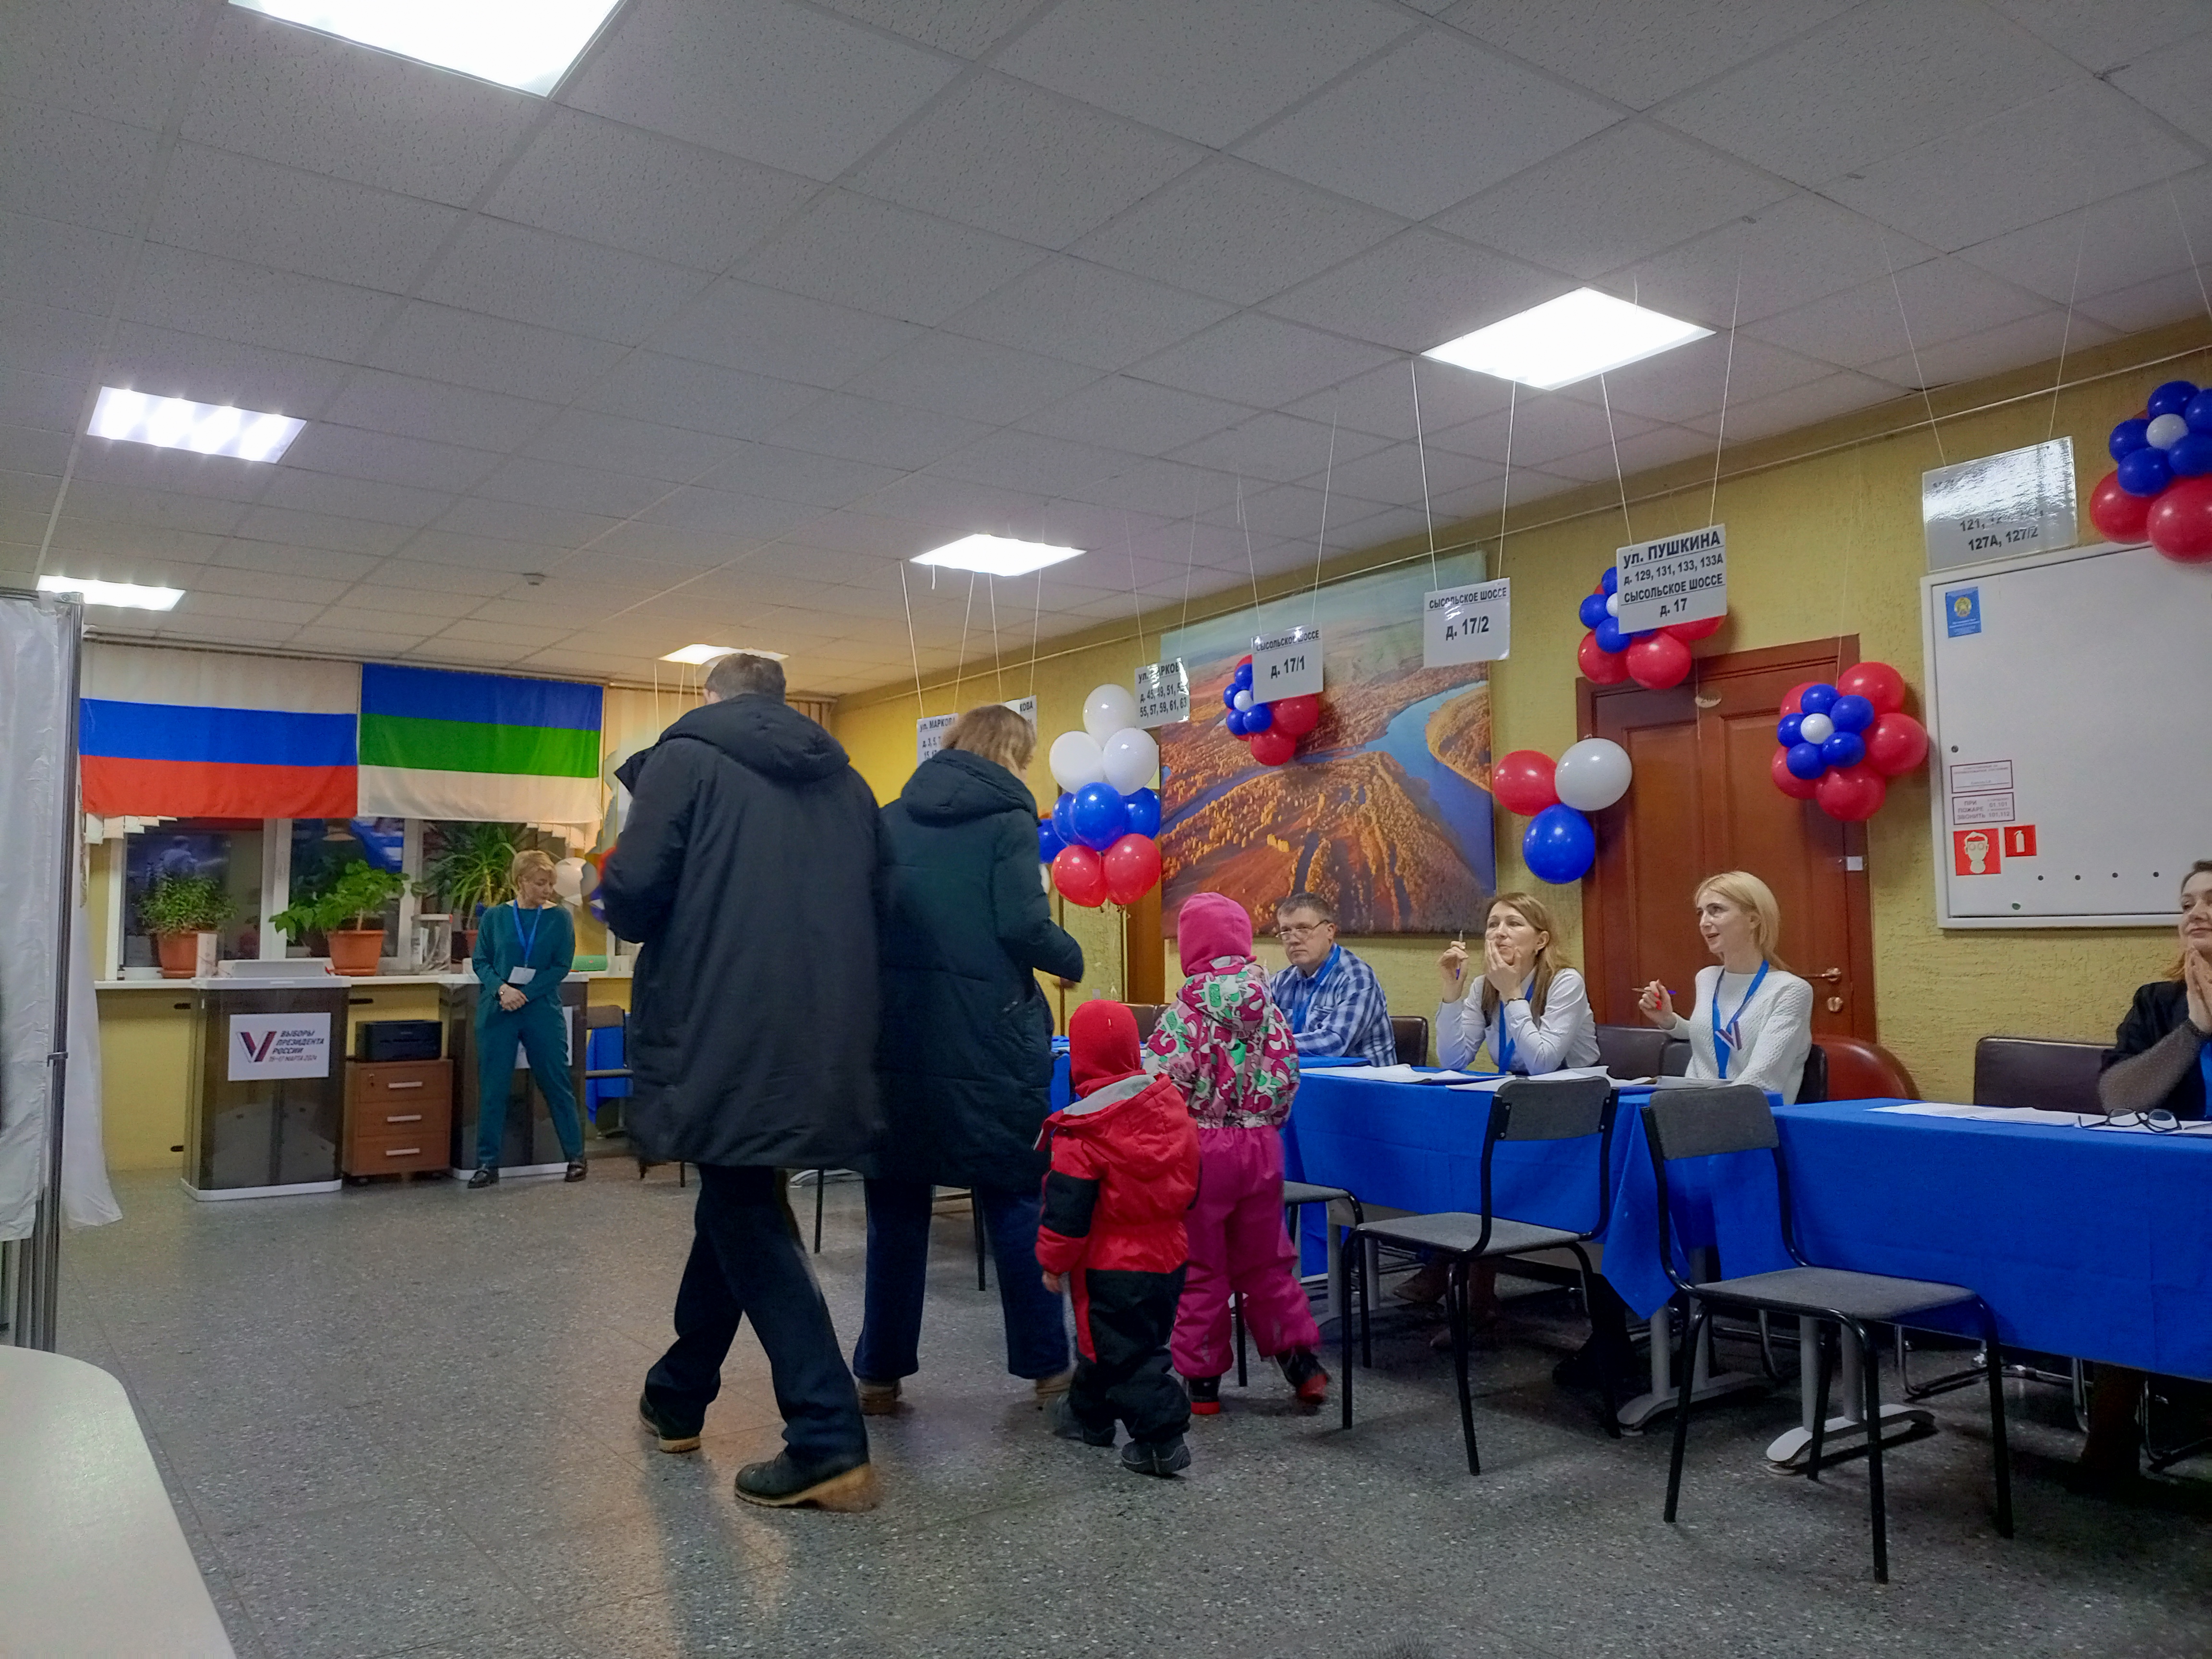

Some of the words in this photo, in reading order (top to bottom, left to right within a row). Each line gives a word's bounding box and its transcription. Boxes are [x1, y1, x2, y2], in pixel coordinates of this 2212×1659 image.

[1960, 518, 1985, 531] 121,
[1623, 553, 1644, 569] ул.
[1648, 531, 1720, 560] ПУШКИНА
[1968, 534, 2002, 551] 127А,
[1623, 576, 1632, 586] д.
[1635, 569, 1654, 581] 129,
[1656, 565, 1675, 576] 131,
[1678, 560, 1698, 571] 133,
[1700, 553, 1723, 568] 133А
[1430, 592, 1479, 609] СЫСОЛЬСКОЕ
[1480, 587, 1507, 600] ШОССЕ
[1624, 581, 1687, 603] СЫСОЛЬСКОЕ
[1689, 573, 1723, 590] ШОССЕ
[1659, 605, 1671, 617] д.
[1674, 598, 1688, 612] 17
[1446, 625, 1457, 641] д.
[1462, 615, 1490, 635] 17/2
[1271, 665, 1280, 679] д.
[1284, 655, 1305, 673] 17/1
[1139, 673, 1149, 684] ул.
[1167, 684, 1176, 696] 51,
[1140, 706, 1148, 718] 55,
[1150, 704, 1158, 716] 57,
[1160, 701, 1168, 714] 59,
[1170, 699, 1178, 711] 61,
[1180, 697, 1187, 709] 63
[276, 1038, 325, 1046] ПРЕЗИДЕНТА
